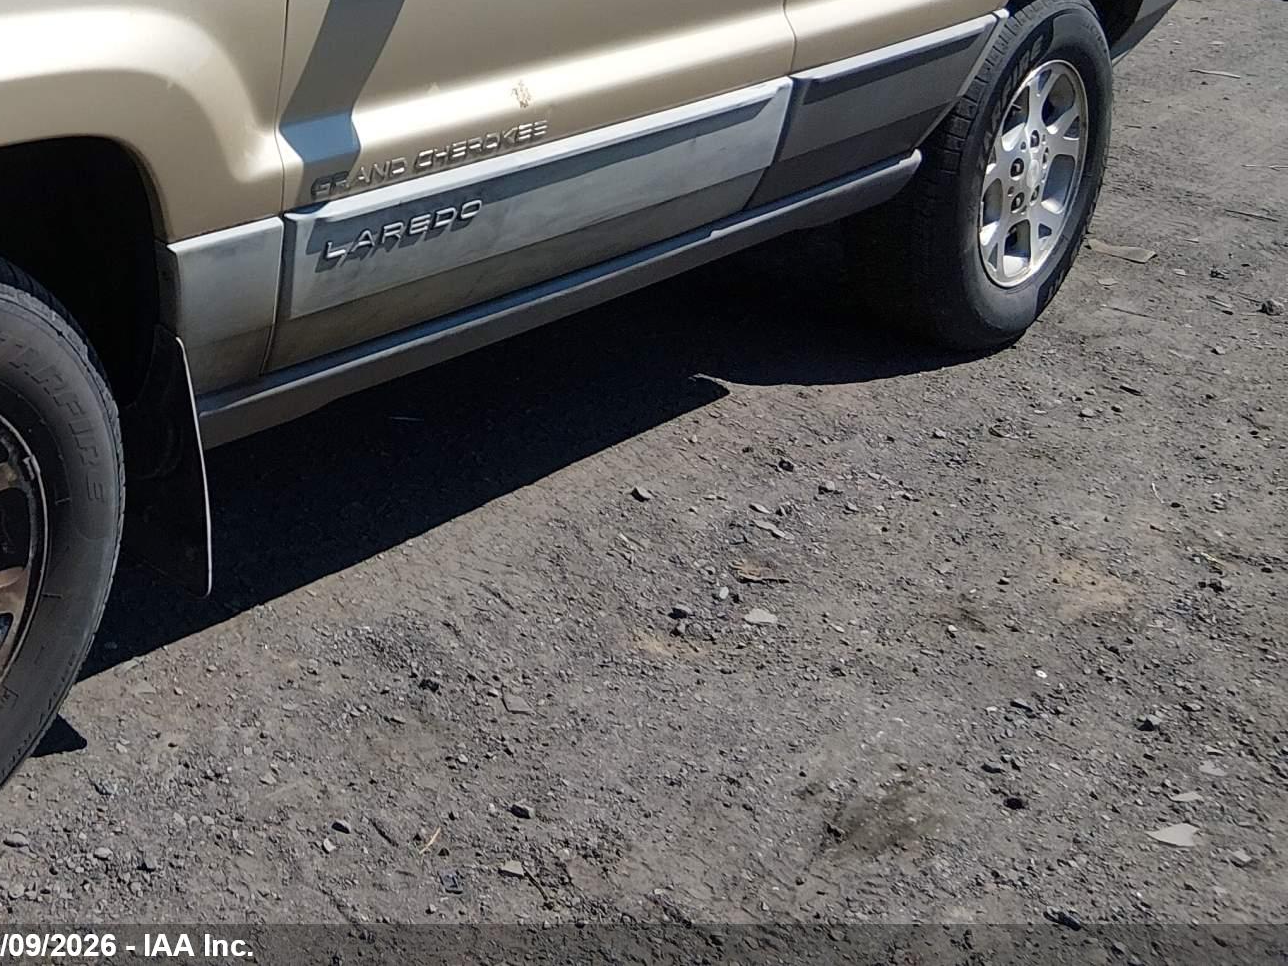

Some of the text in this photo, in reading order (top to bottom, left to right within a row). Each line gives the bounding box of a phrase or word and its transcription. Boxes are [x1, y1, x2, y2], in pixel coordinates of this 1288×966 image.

[310, 120, 550, 198] GRAND CHEROKEE
[325, 199, 483, 260] LAREDO
